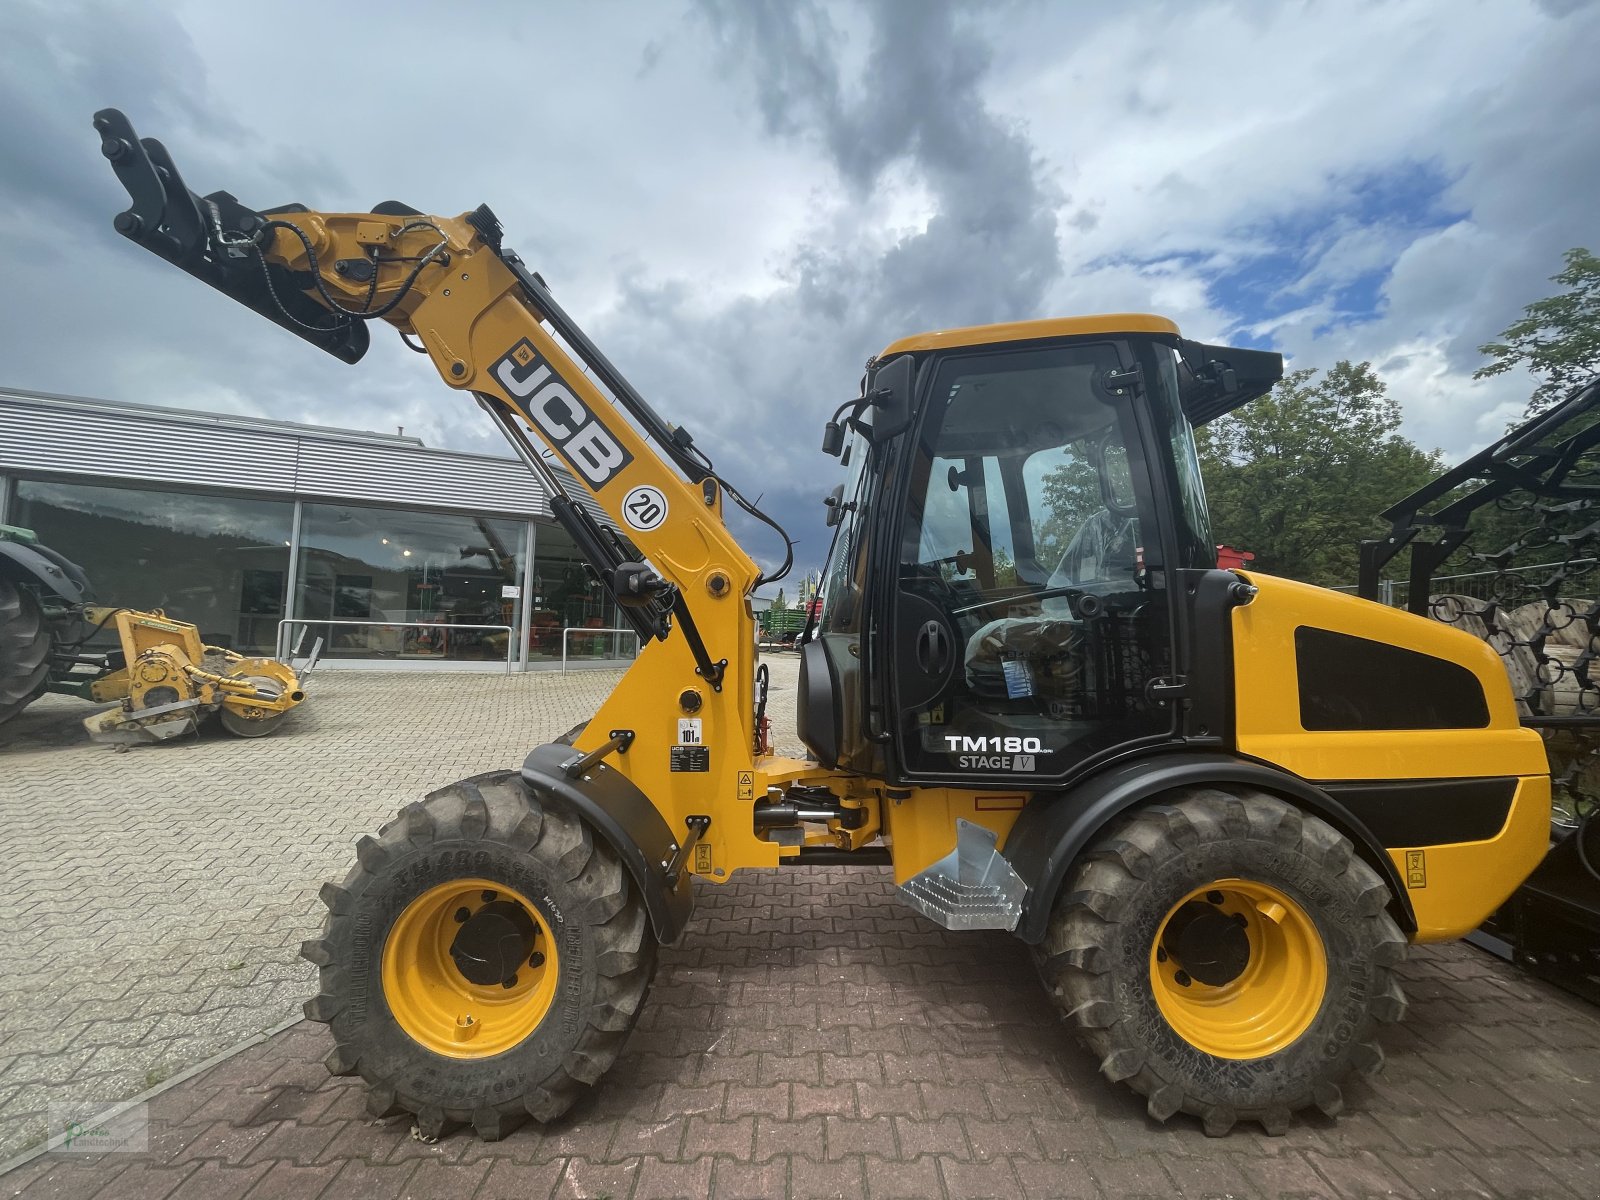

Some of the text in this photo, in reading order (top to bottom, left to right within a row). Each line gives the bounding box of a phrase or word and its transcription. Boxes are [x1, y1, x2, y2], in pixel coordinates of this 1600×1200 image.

[497, 358, 624, 483] JCB
[628, 493, 661, 525] 20
[944, 735, 1041, 753] TM180
[959, 755, 1031, 769] STAGE V
[563, 924, 583, 1036] TRELLEBORG
